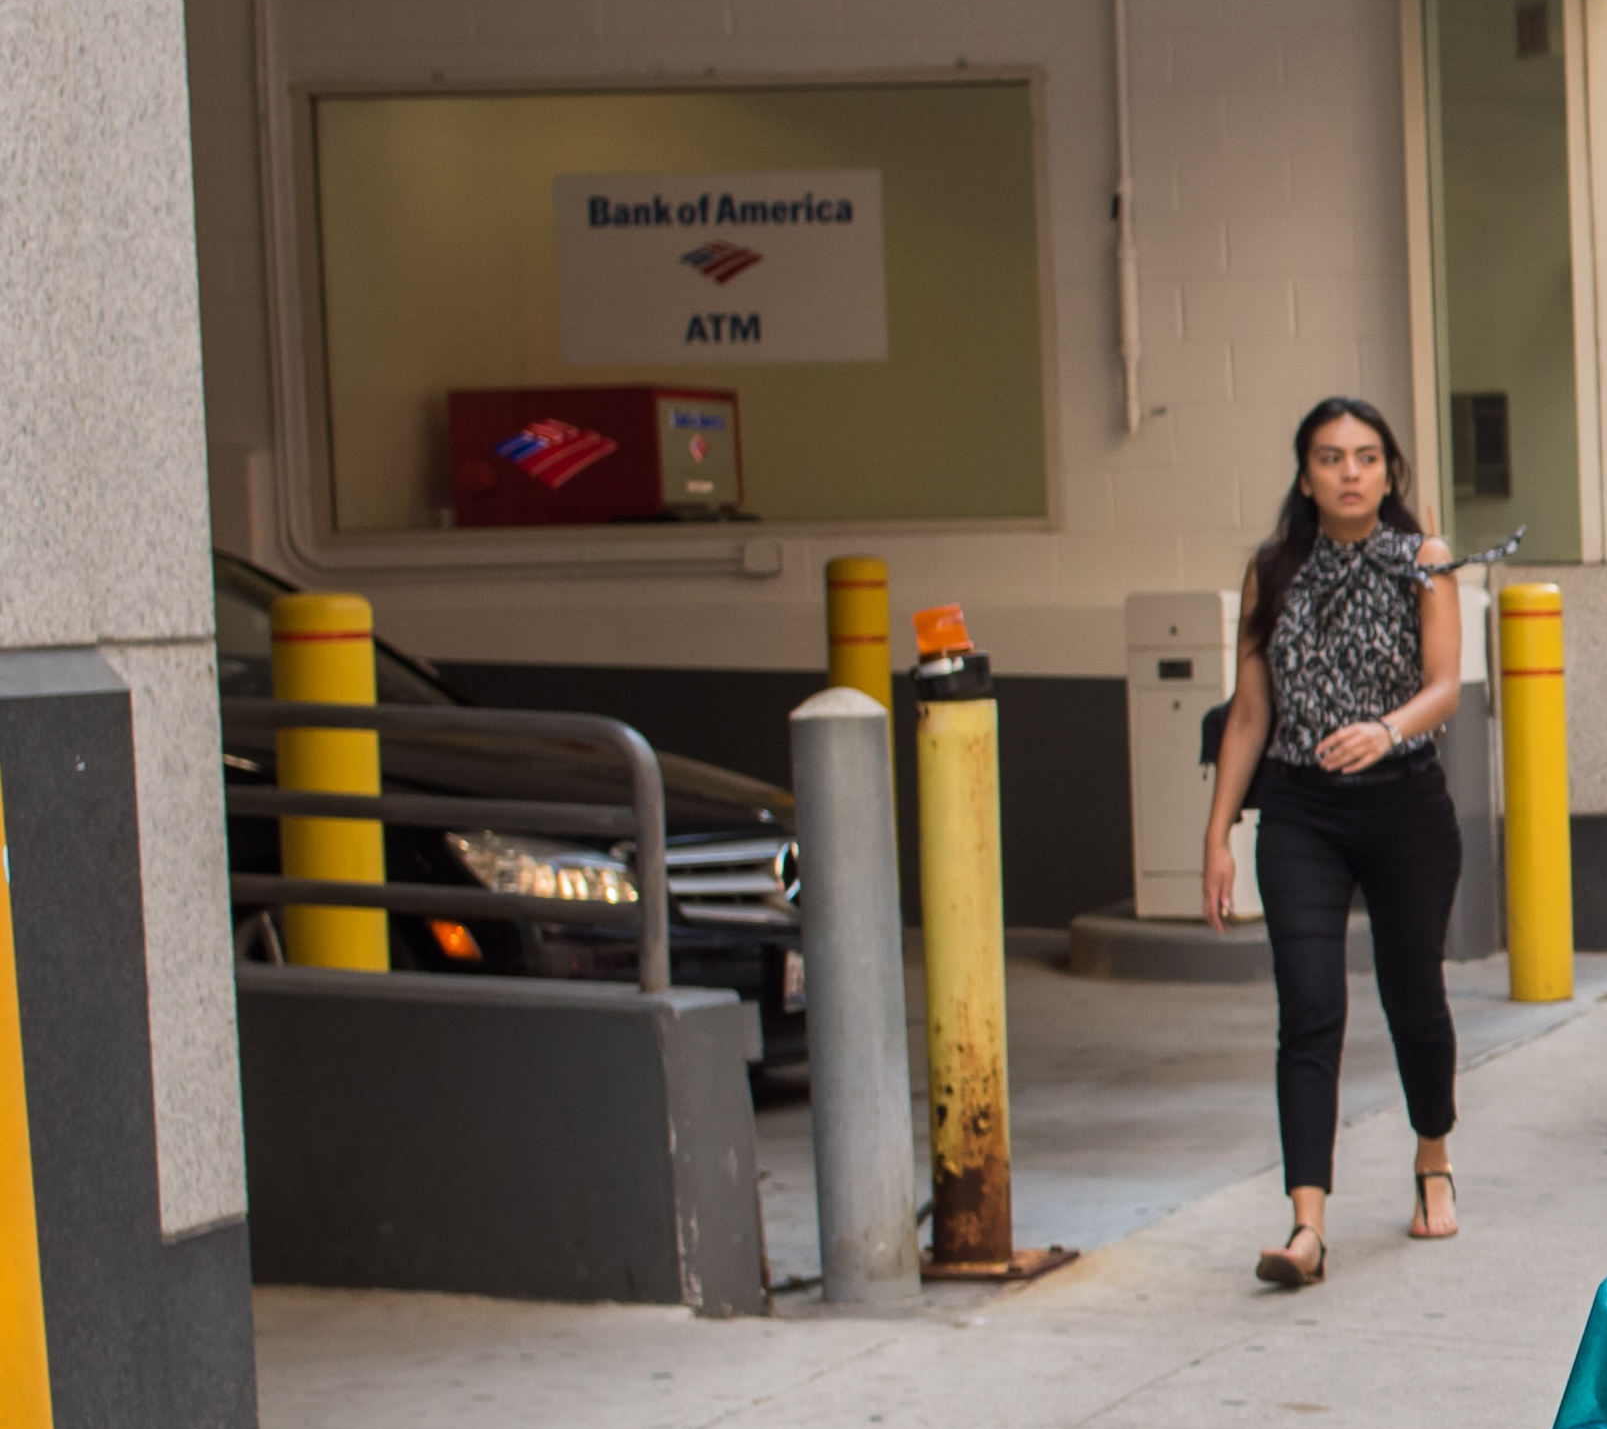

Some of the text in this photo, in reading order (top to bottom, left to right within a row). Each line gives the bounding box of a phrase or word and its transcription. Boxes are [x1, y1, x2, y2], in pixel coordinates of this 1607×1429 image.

[588, 191, 854, 227] Bank of America
[684, 313, 763, 345] ATM
